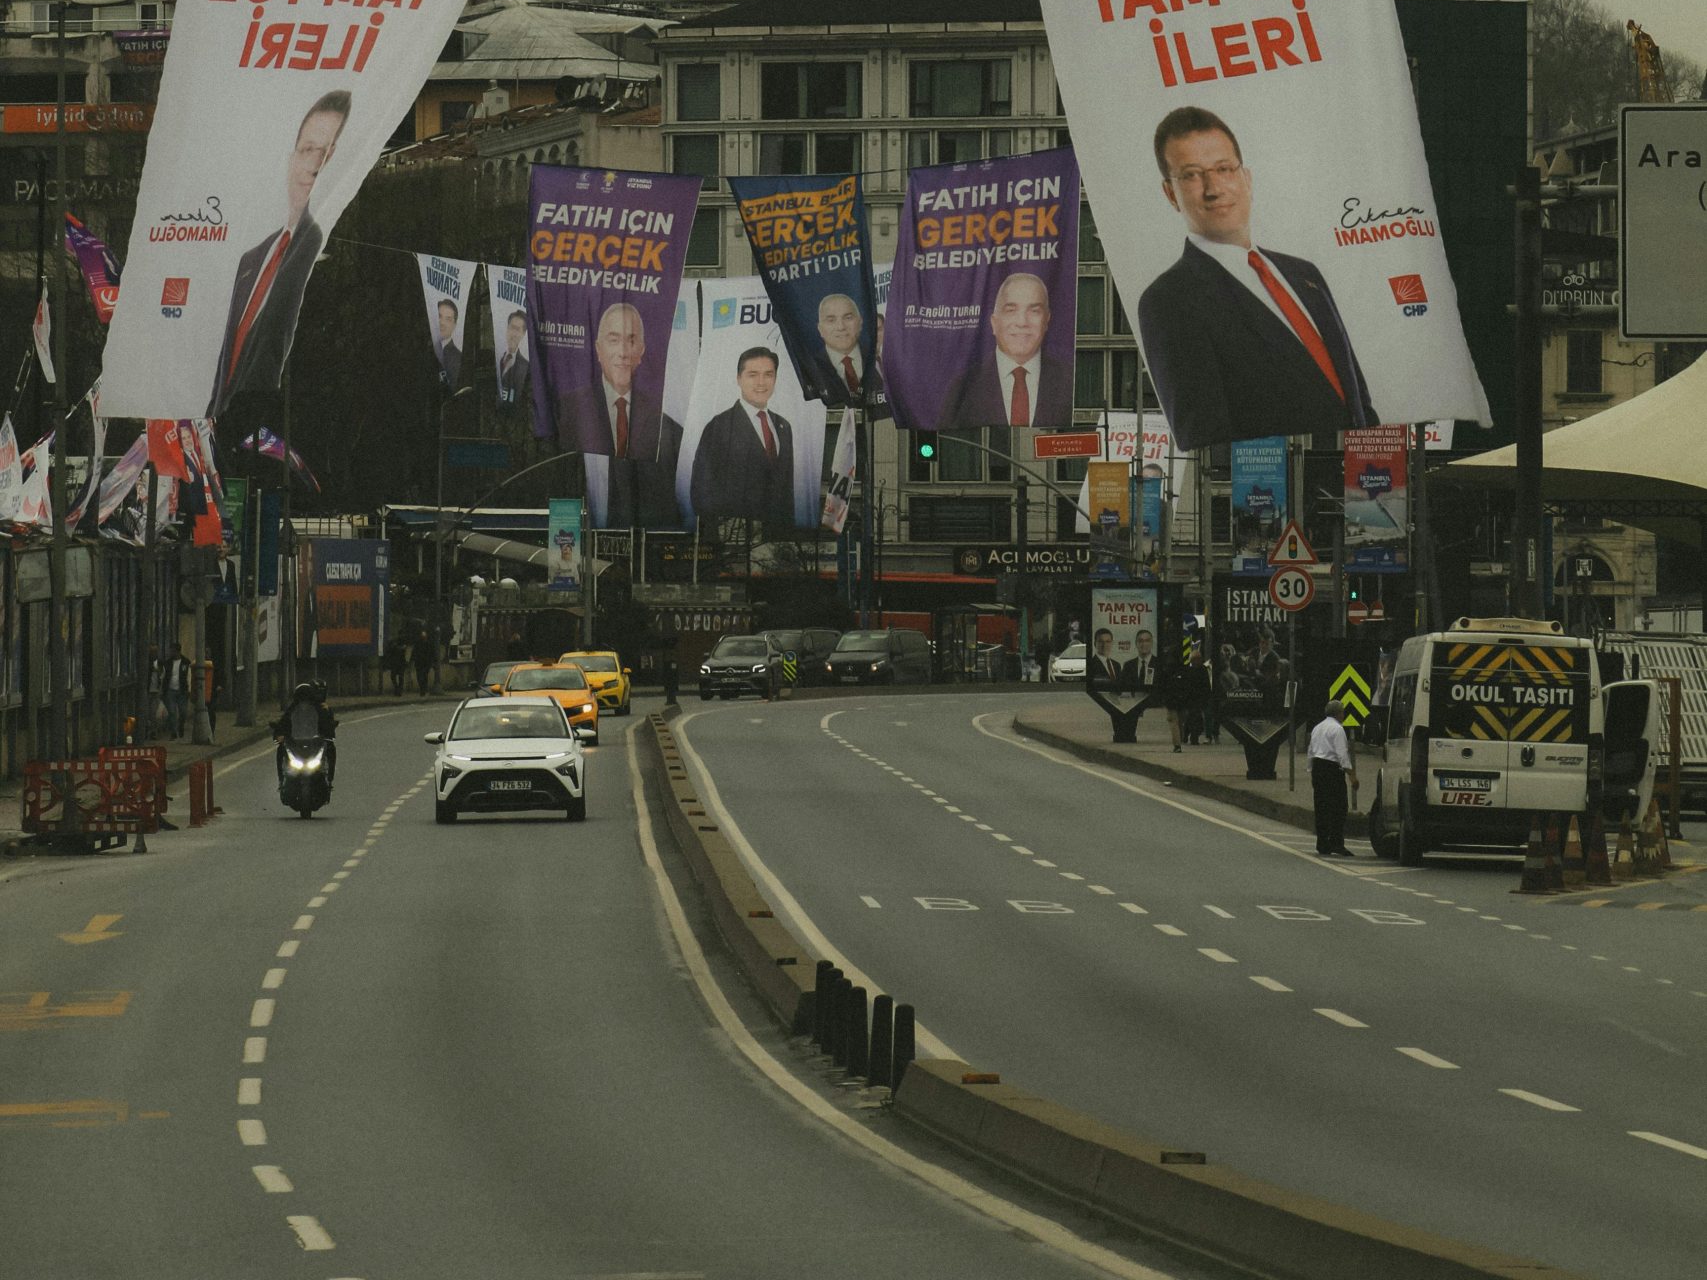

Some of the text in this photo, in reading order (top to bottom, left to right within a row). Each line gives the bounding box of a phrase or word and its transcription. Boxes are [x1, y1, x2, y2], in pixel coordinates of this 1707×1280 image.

[918, 176, 1061, 212] FATİH İÇİN
[743, 195, 813, 216] STANBUL
[536, 202, 675, 236] FATİH İÇİN
[917, 204, 1060, 248] GERÇEK
[1334, 216, 1435, 247] İMAMOĞLU
[531, 230, 669, 272] GERÇEK
[913, 241, 1059, 270] BELEDİYECİLİK
[1403, 304, 1428, 318] CHP
[1006, 565, 1073, 573] BALAVALARI
[1227, 587, 1275, 605] İSTAN
[1279, 578, 1306, 598] 30
[1097, 602, 1152, 613] TAM YOL
[1109, 612, 1141, 625] İLERİ
[1451, 684, 1574, 707] OKUL TAŞITI
